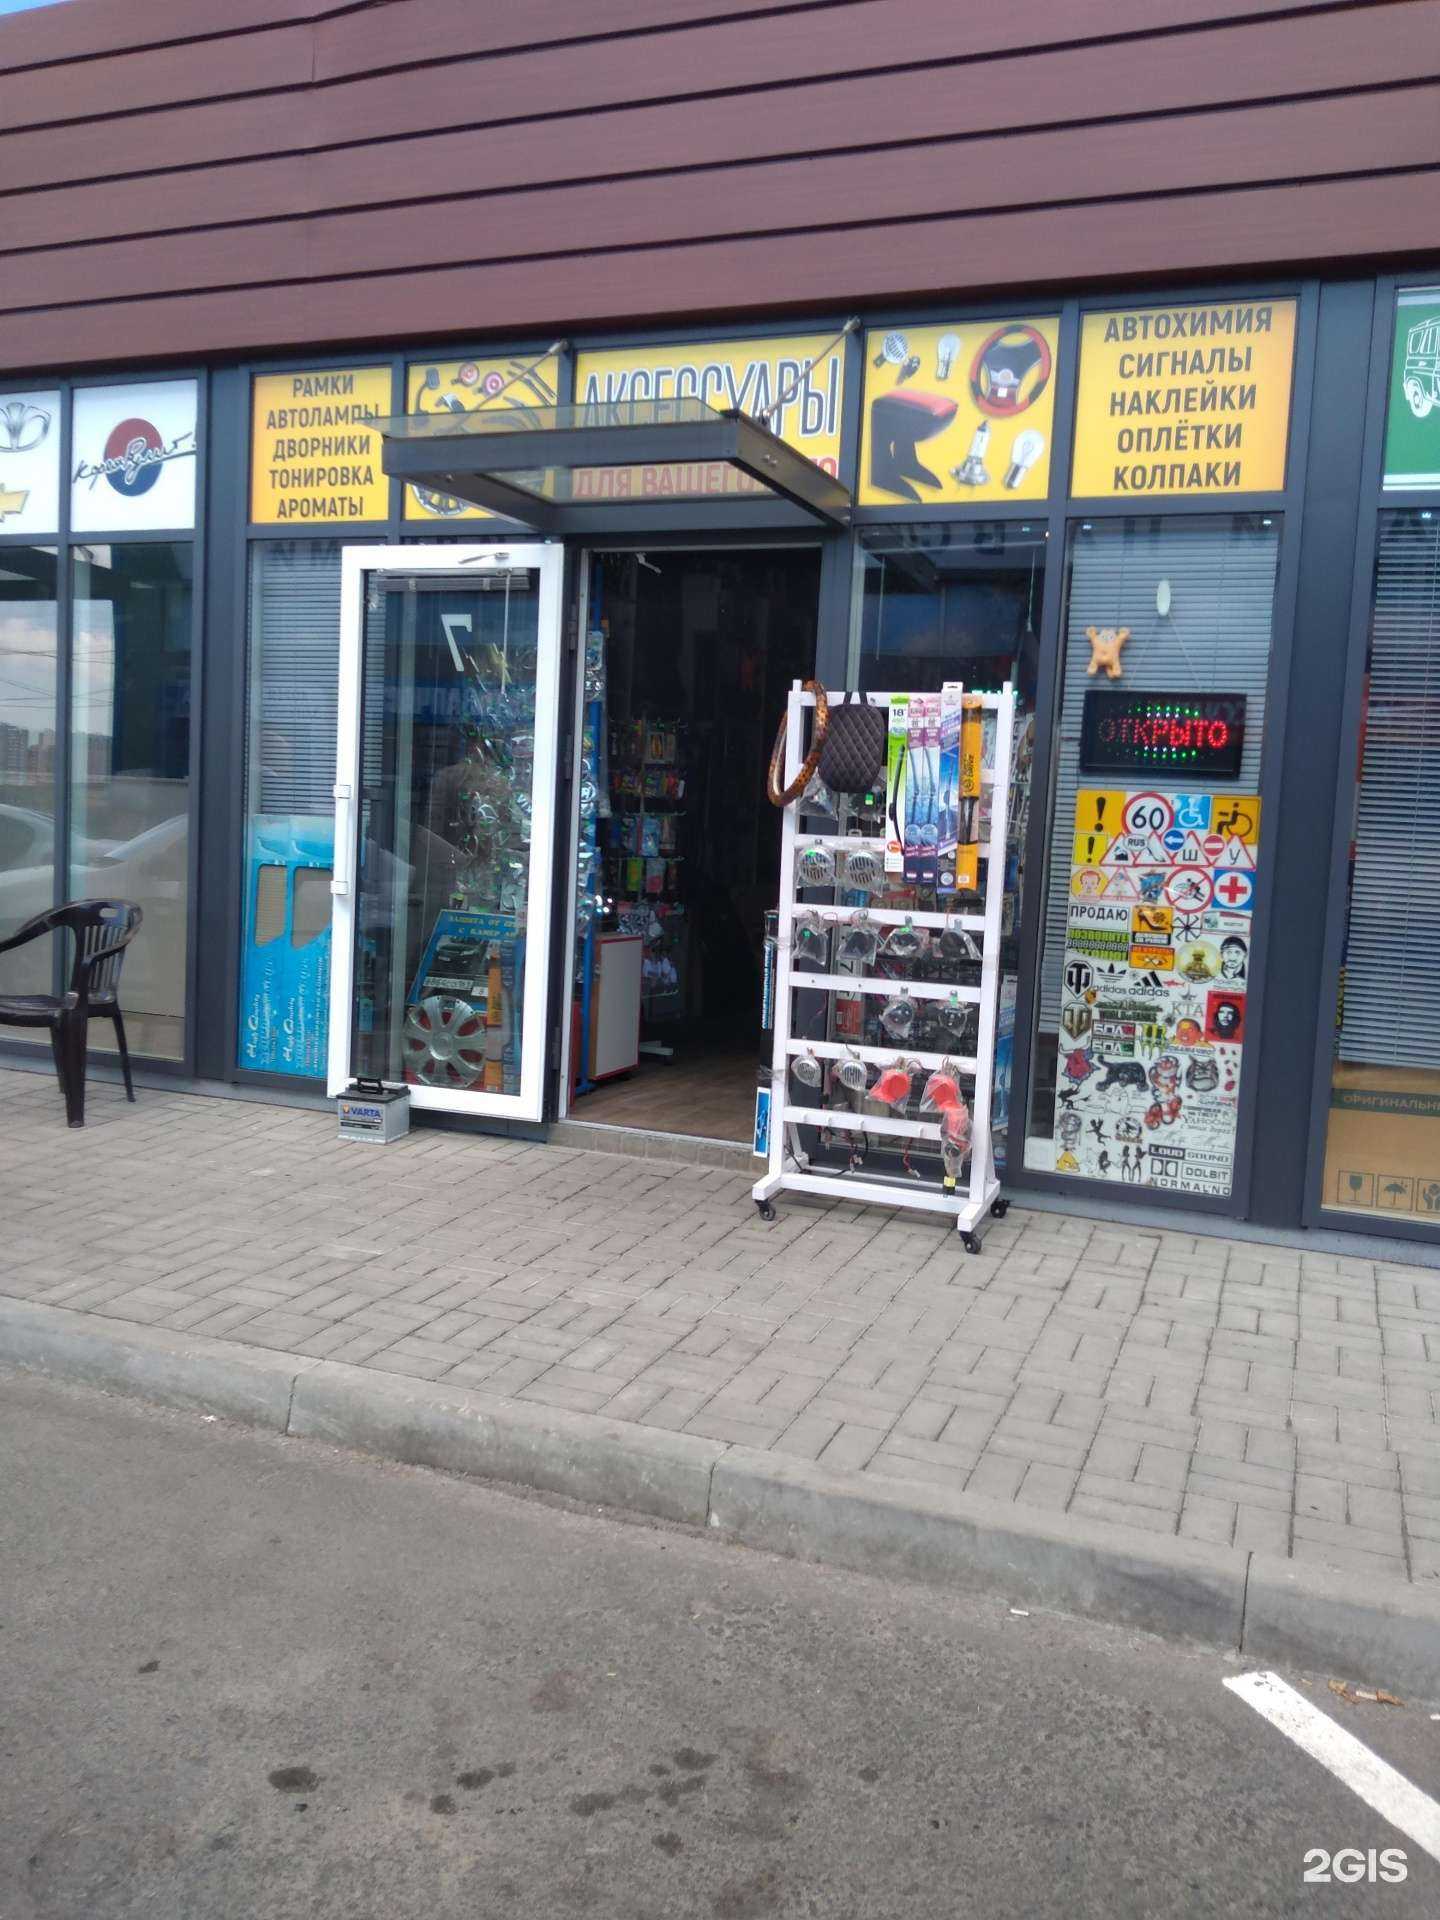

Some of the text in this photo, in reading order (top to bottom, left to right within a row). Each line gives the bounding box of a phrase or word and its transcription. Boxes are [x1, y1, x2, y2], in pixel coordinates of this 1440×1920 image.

[1104, 306, 1272, 343] АВТОХИМИЯ
[1119, 346, 1252, 379] СИГНАЛЫ
[293, 375, 353, 397] РАМКИ
[584, 357, 841, 436] АКСЕССУАРЫ
[1110, 379, 1256, 416] НАКЛЕЙКИ
[266, 403, 380, 429] АВТОЛАМПЫ
[272, 435, 370, 462] ДВОРНИКИ
[1117, 419, 1242, 453] ОПЛЁТКИ
[269, 465, 374, 489] ТОНИРОВКА
[576, 468, 632, 498] ДЛЯ
[1113, 461, 1241, 490] КОЛПАКИ
[277, 496, 364, 518] АРОМАТЫ
[1098, 718, 1230, 749] ОТКРЫТО
[1131, 805, 1165, 830] 60
[1127, 838, 1146, 847] RUS
[1070, 905, 1128, 921] ПРОДАЮ
[1128, 985, 1171, 998] adidas
[351, 1106, 382, 1118] VARTA
[1150, 1146, 1229, 1163] LOUD SOUND
[1185, 1167, 1229, 1181] DOLBIT
